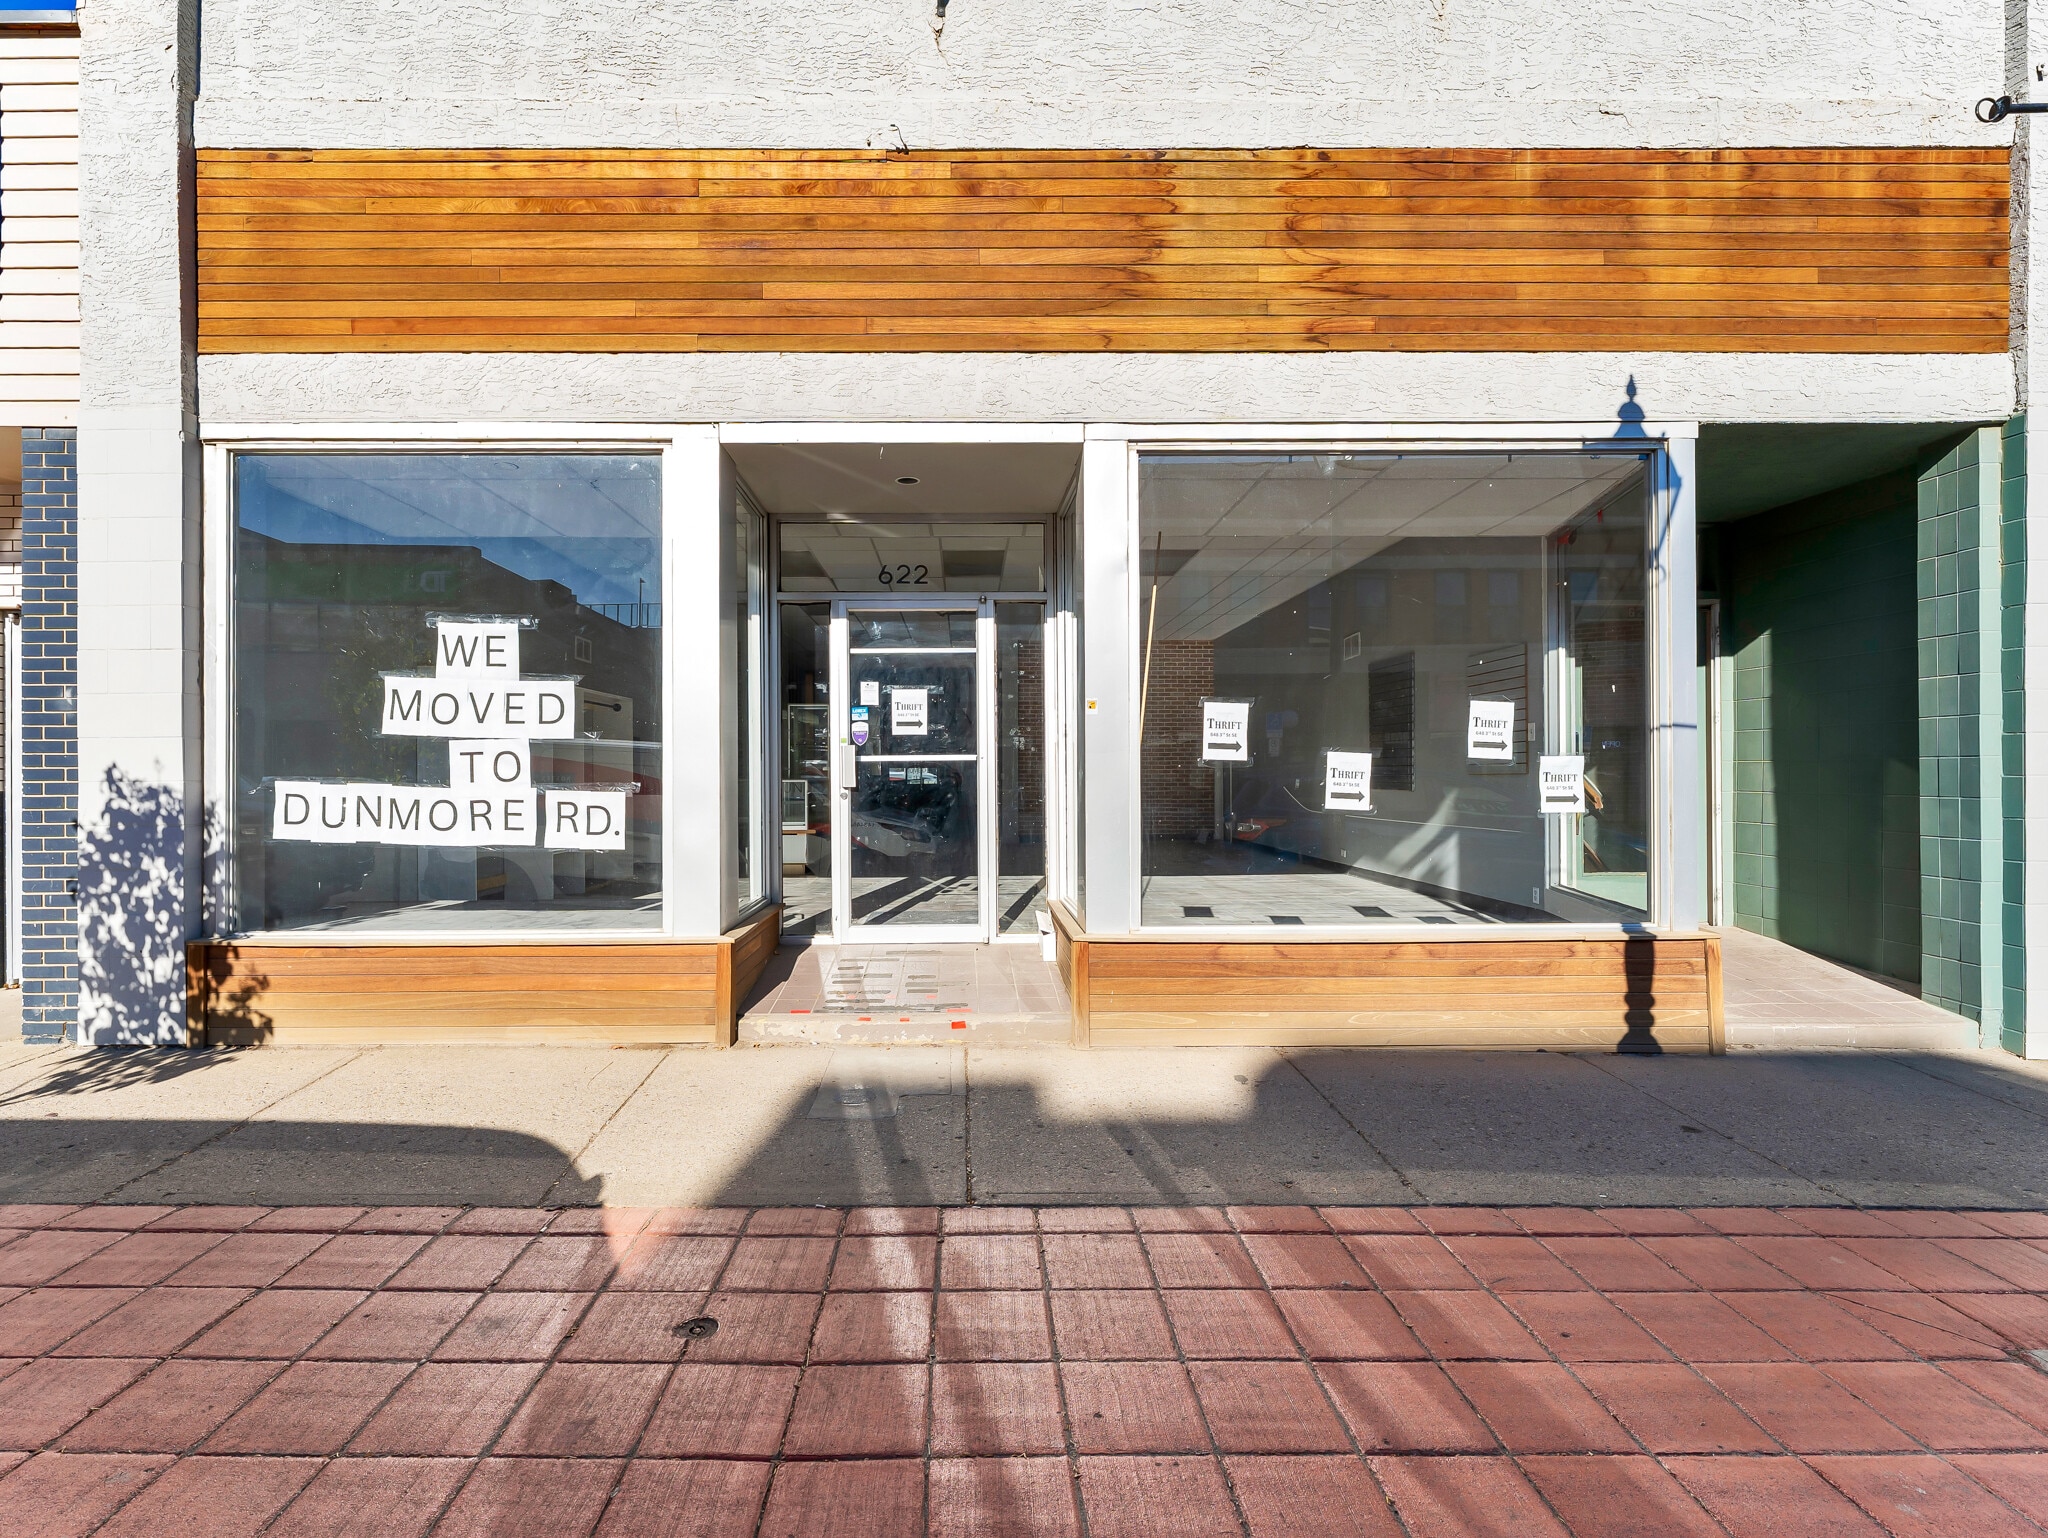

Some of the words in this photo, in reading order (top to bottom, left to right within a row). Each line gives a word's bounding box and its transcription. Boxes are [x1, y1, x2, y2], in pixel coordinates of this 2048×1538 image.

[878, 564, 929, 585] 622
[441, 634, 507, 668] WE
[389, 688, 566, 725] MOVED
[459, 750, 521, 783] TO
[284, 793, 525, 832] DUNMORE
[556, 801, 621, 837] RD.
